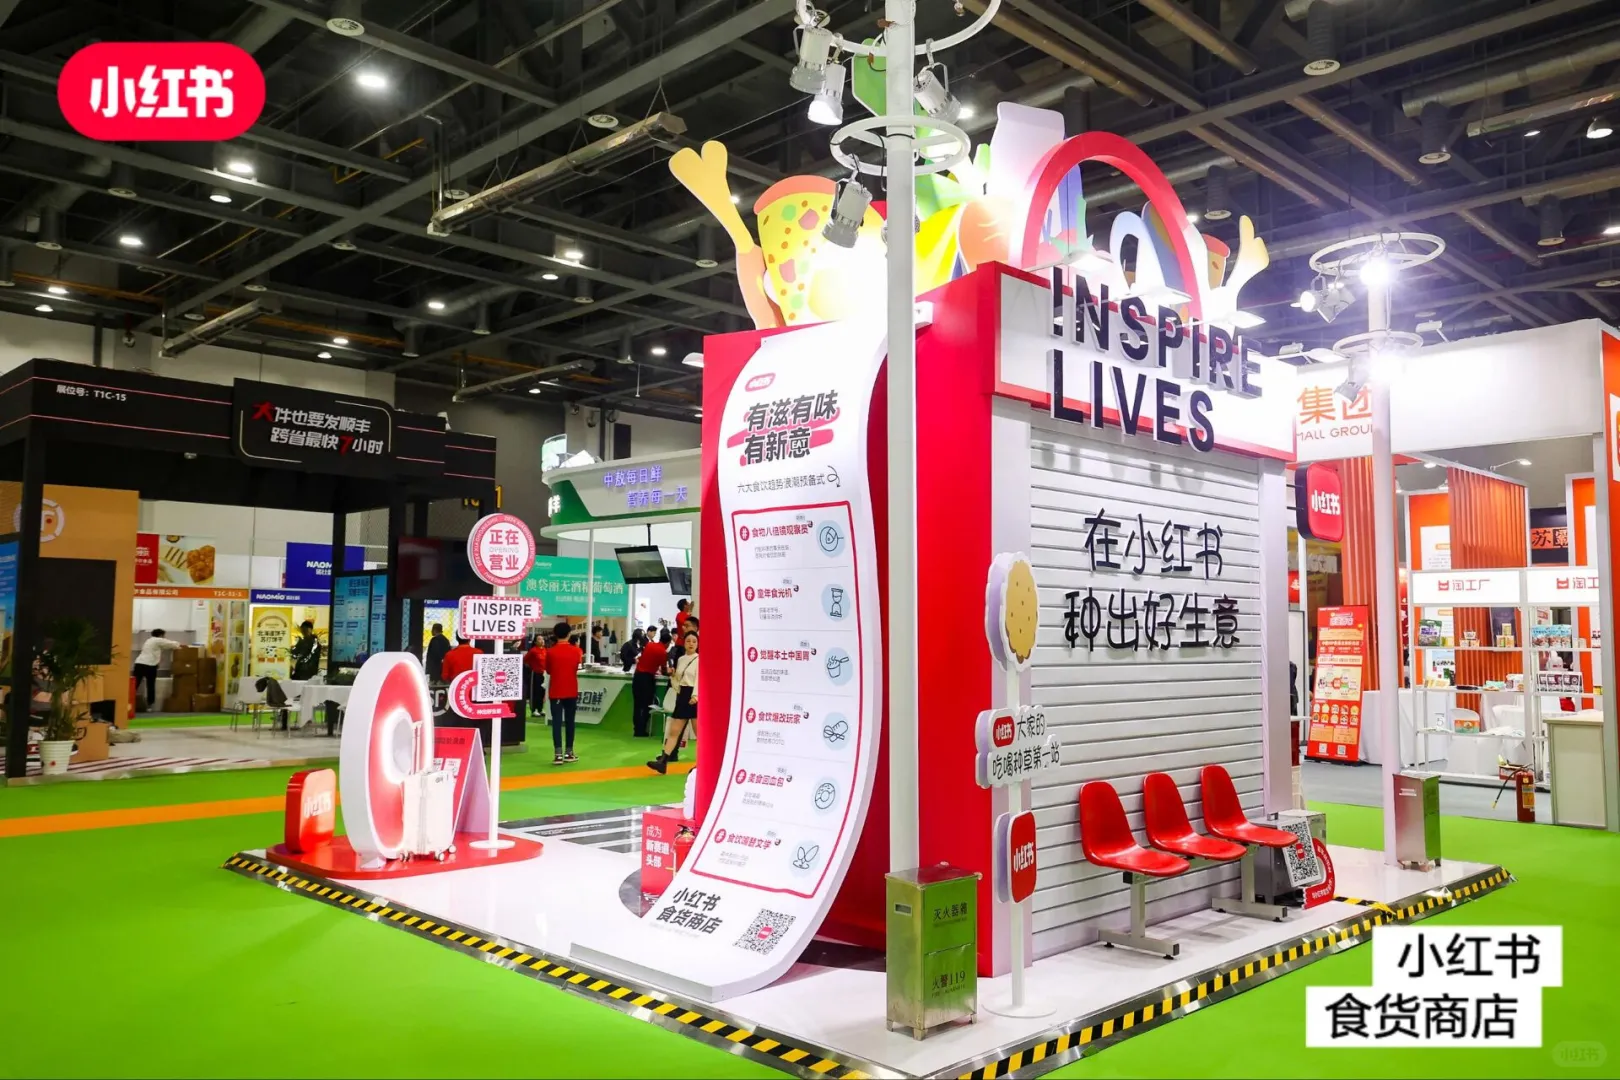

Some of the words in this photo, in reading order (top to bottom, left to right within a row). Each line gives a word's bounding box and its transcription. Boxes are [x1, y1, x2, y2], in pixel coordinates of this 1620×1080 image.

[1050, 266, 1263, 399] INSPIRE
[747, 389, 838, 431] 有滋有味
[1047, 349, 1215, 453] LIVES
[252, 401, 371, 433] 大件也要发顺丰
[270, 427, 384, 456] 跨省最快7小时
[1330, 424, 1373, 438] GROU
[744, 427, 811, 465] 有新意
[604, 465, 662, 488] 中敖每日鲜
[627, 485, 688, 508] 营养每一天
[1311, 489, 1341, 515] 小红书
[489, 529, 519, 545] 正在
[1084, 508, 1223, 580] 在小红书
[489, 554, 519, 571] 营业
[1452, 579, 1491, 591] 淘工厂
[1572, 576, 1600, 589] 淘工
[473, 602, 532, 616] INSPIRE
[1064, 586, 1240, 652] 种出好生意
[472, 619, 516, 633] LIVES
[995, 723, 1012, 741] 小红书
[1017, 713, 1046, 740] 大家的
[993, 742, 1060, 780] 吃喝种草第一站
[646, 854, 662, 869] 头部
[1013, 842, 1034, 873] 小红书
[673, 887, 721, 912] 小红书
[933, 901, 968, 921] 灭火器箱
[656, 905, 723, 934] 食货商店
